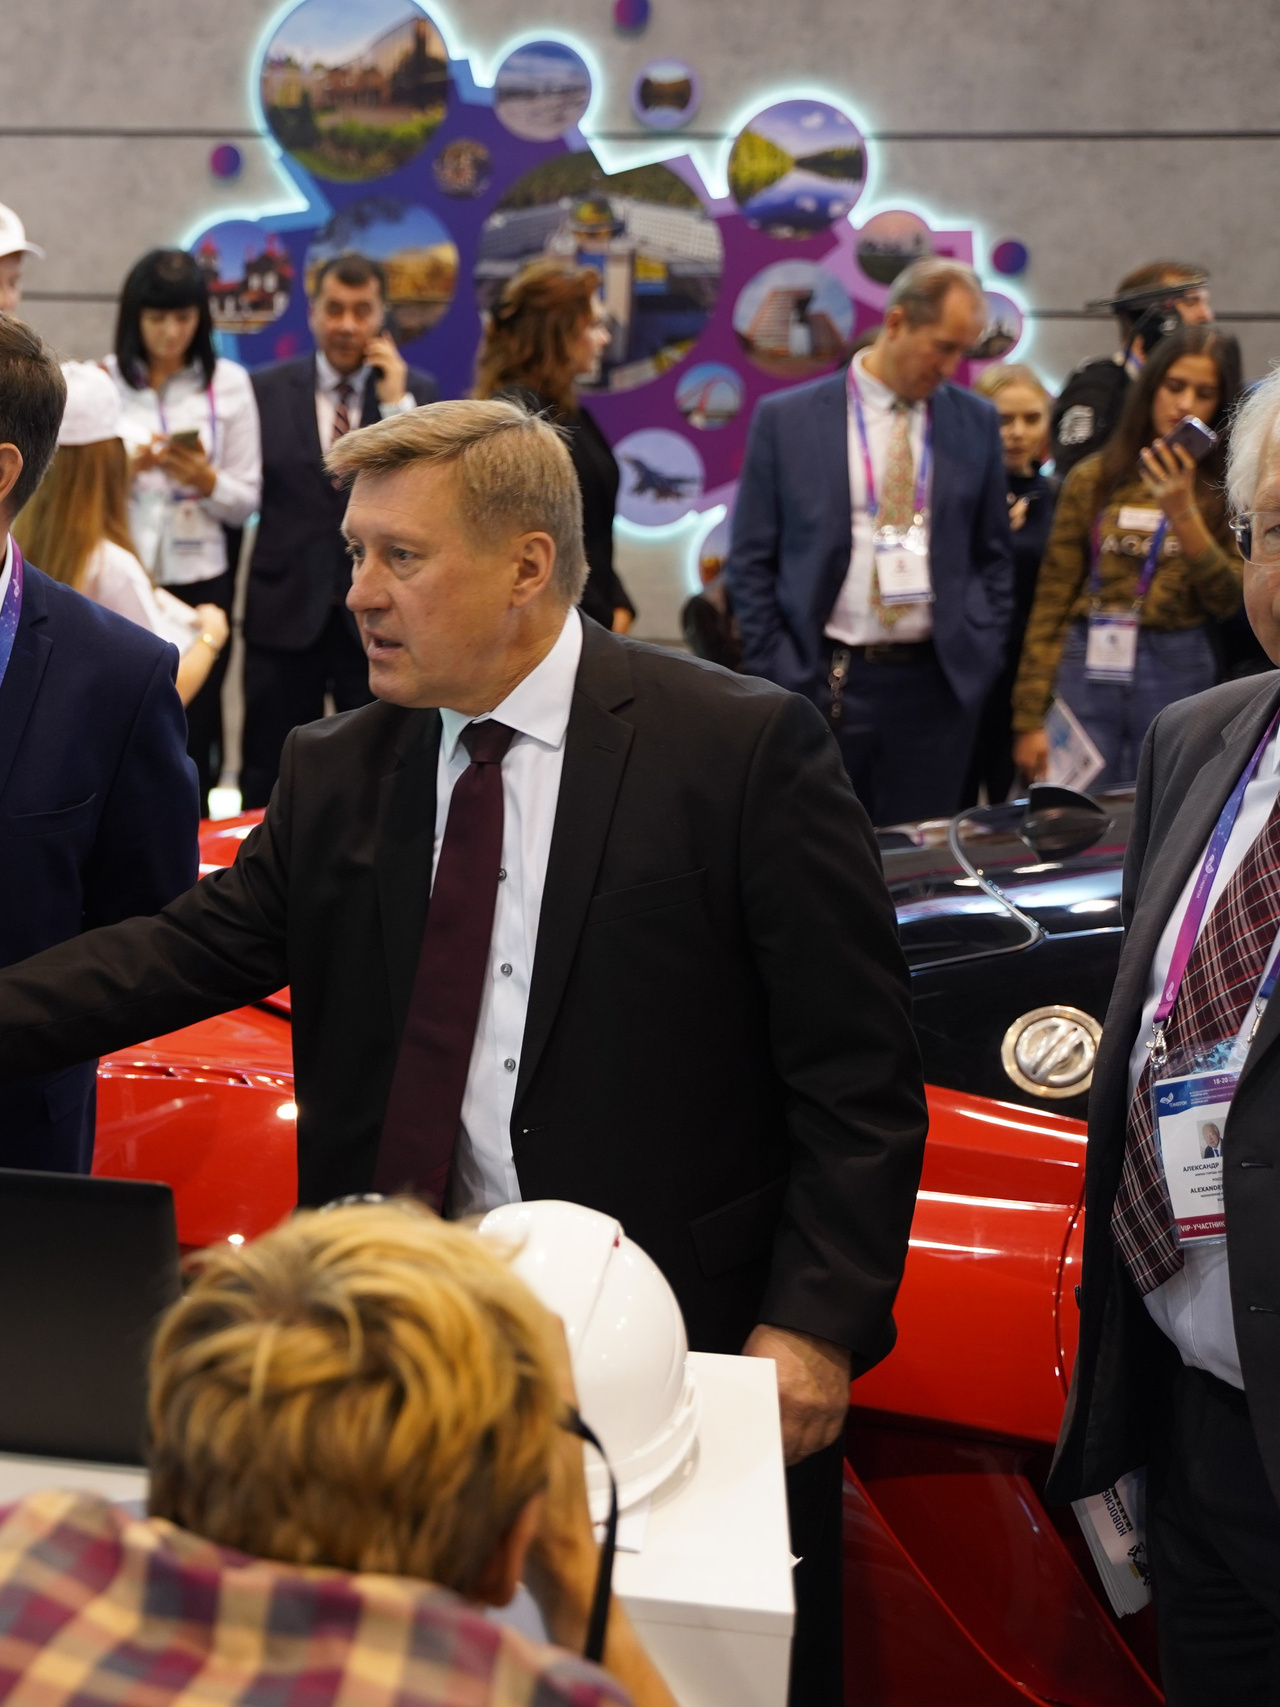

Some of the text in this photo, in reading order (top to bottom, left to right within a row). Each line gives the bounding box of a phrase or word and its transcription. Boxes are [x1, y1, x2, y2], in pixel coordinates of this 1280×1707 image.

[1182, 1162, 1220, 1173] АЛЕКСАНДР
[1190, 1184, 1224, 1194] ALEXANDE
[1180, 1220, 1226, 1232] VIP-УЧАСТНИК
